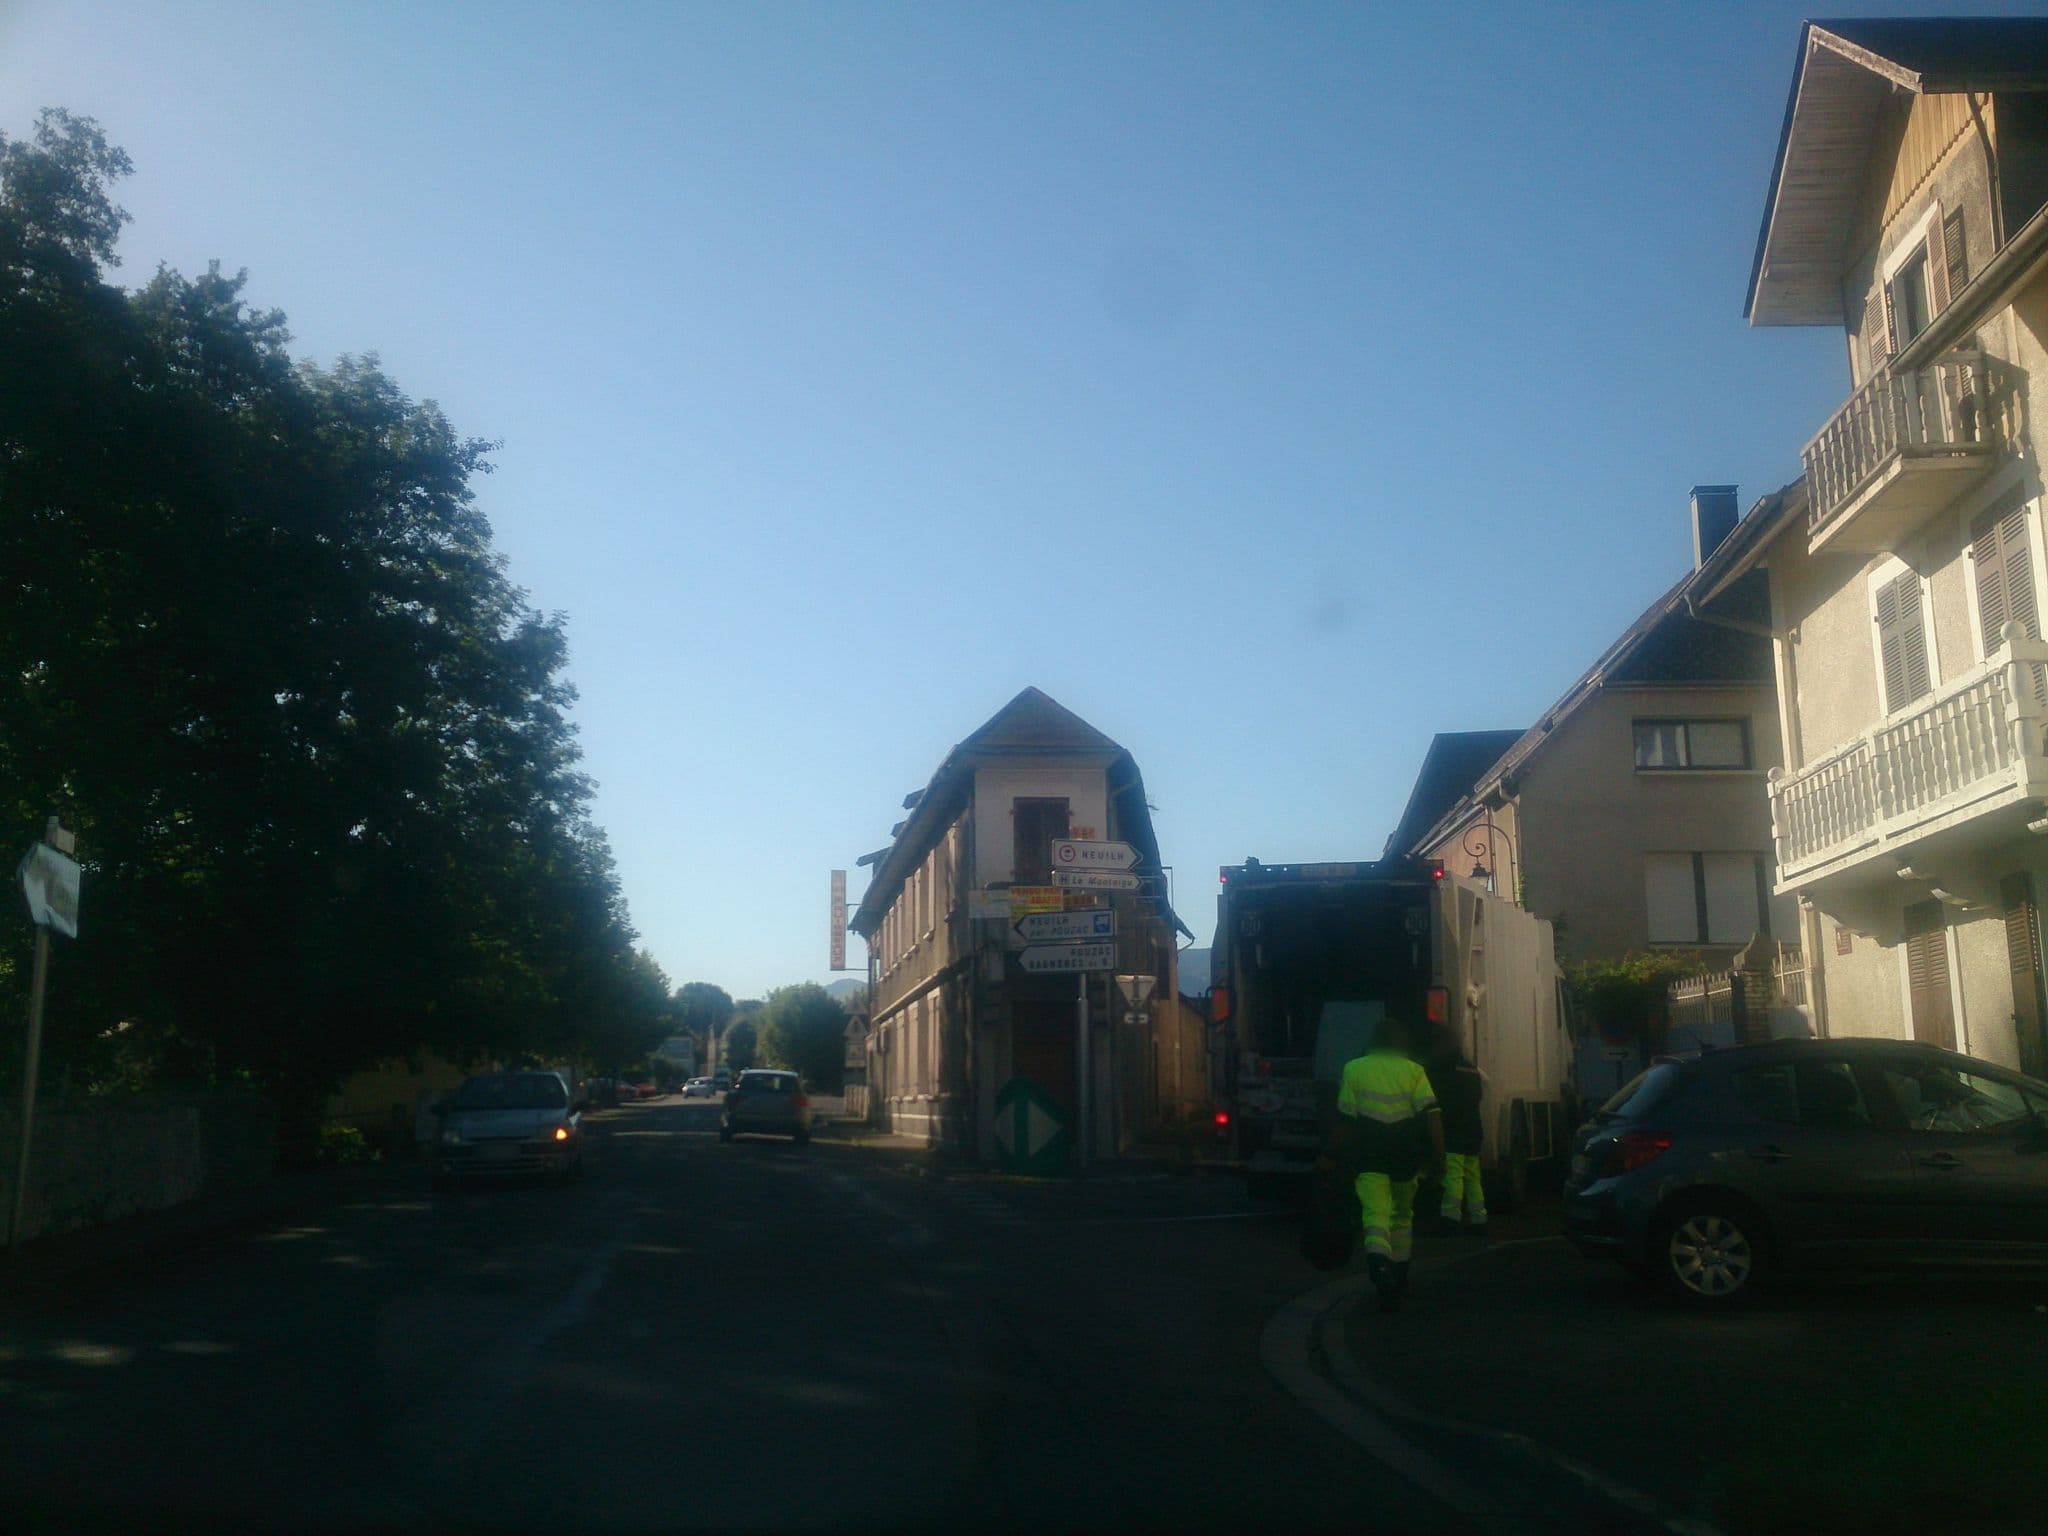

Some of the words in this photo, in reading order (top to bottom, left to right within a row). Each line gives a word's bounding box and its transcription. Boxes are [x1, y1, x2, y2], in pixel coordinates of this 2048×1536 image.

[1082, 848, 1124, 861] NEUILH
[1029, 915, 1069, 926] NEUILH
[1050, 925, 1089, 937] POUZAC
